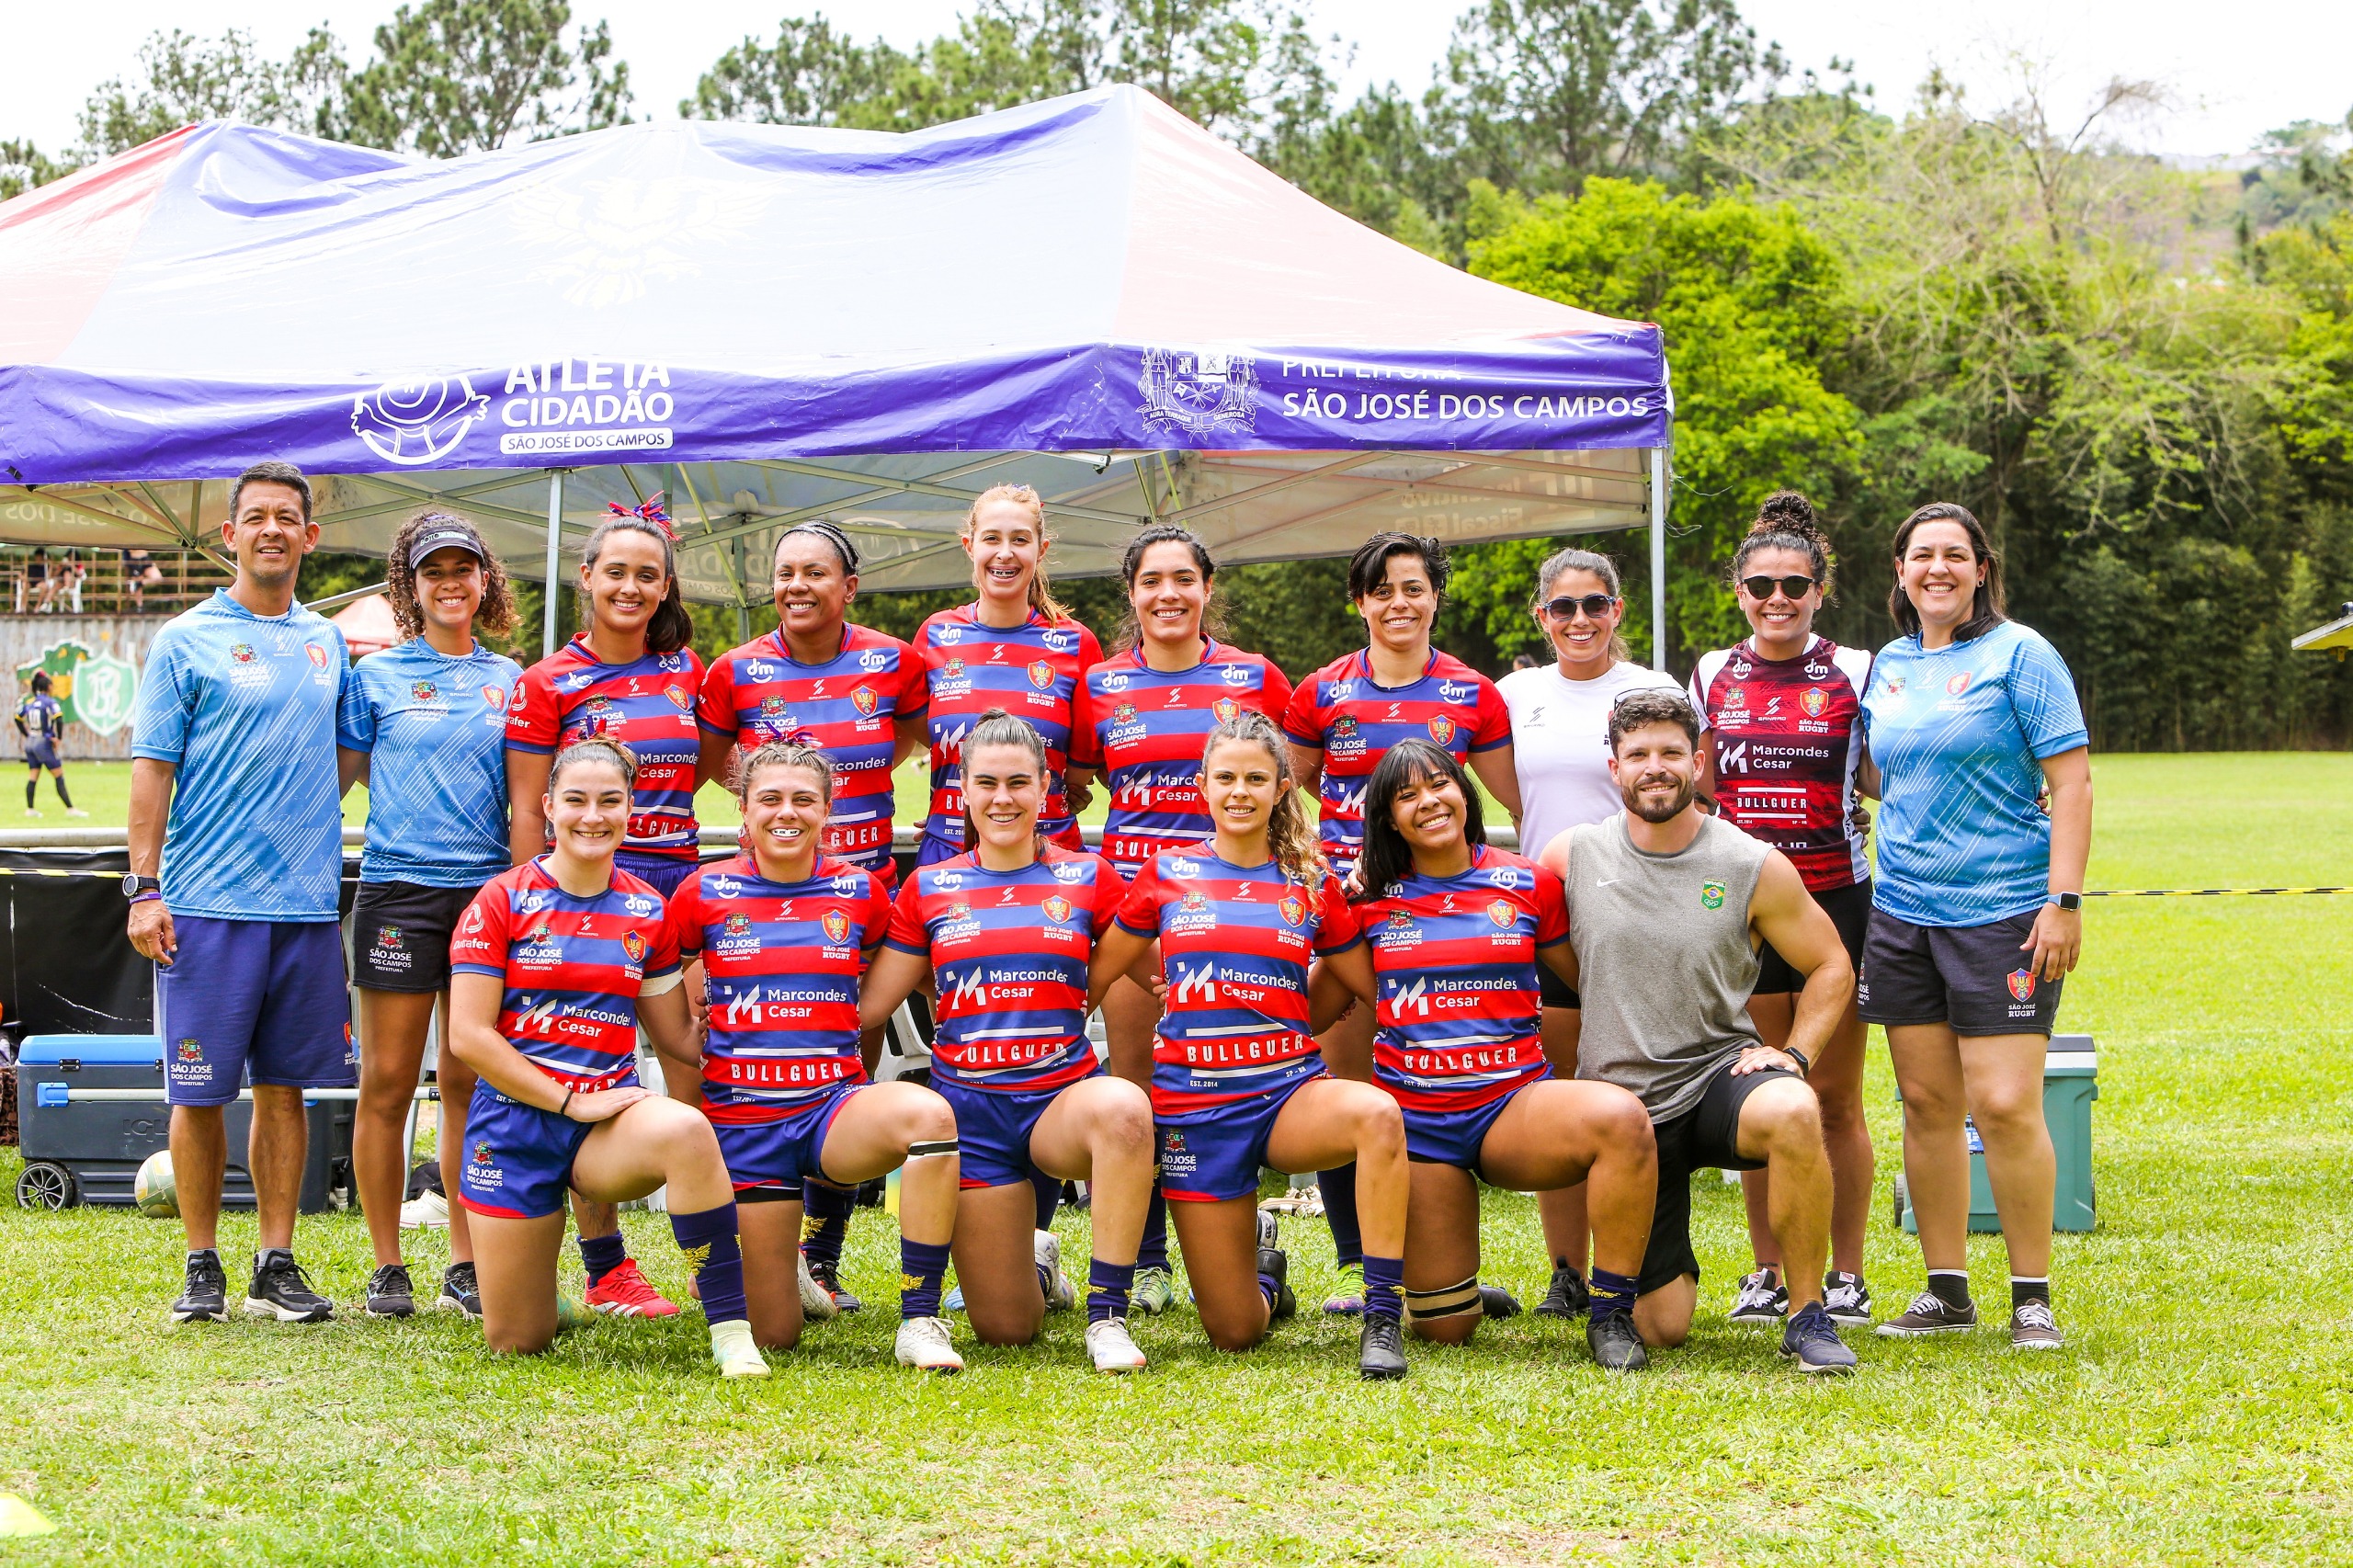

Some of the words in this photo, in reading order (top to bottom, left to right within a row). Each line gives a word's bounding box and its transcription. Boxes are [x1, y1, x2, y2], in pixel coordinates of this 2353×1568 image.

[502, 390, 674, 427] CIDADÃO
[1282, 389, 1347, 418] SÃO
[1354, 389, 1429, 419] JOSÉ
[1439, 394, 1505, 419] DOS
[1513, 395, 1649, 418] CAMPOS
[508, 435, 534, 449] SÃO
[539, 433, 571, 449] JOSÉ
[574, 435, 603, 448] DOS
[607, 433, 664, 447] CAMPOS
[935, 681, 949, 691] SÃO
[949, 679, 972, 688] JOSÉ
[1027, 698, 1055, 708] RUGBY
[1731, 710, 1750, 718] JOSÉ
[856, 723, 881, 732] RUGBY
[1108, 727, 1124, 741] SÃO
[1125, 723, 1146, 735] JOSÉ
[1798, 725, 1828, 733] RUGBY
[1108, 739, 1119, 747] DOS
[1120, 734, 1146, 744] CAMPOS
[1114, 742, 1138, 751] PREFEITURA
[1342, 738, 1367, 749] JOSÉ
[1753, 744, 1829, 757] Marcondes
[831, 756, 886, 772] rcondes
[1753, 758, 1791, 769] Cesar
[640, 768, 676, 778] Cesar
[1156, 790, 1198, 802] Cesar
[1737, 798, 1806, 808] BULLGUER
[831, 826, 879, 847] GUER
[1171, 915, 1191, 926] SÃO
[1190, 913, 1216, 925] JOSÉ
[938, 924, 954, 937] SÃO
[955, 921, 981, 932] JOSÉ
[1278, 928, 1292, 937] SÃO
[1292, 932, 1305, 941] JOSÉ
[1380, 931, 1397, 942] SÃO
[1398, 928, 1423, 939] JOSÉ
[716, 938, 733, 949] SÃO
[734, 937, 760, 948] JOSÉ
[938, 935, 949, 944] DOS
[949, 929, 981, 940] CAMPOS
[942, 937, 971, 947] PREFEITURA
[1043, 932, 1073, 942] RUGBY
[1277, 935, 1305, 949] RUGBY
[1392, 938, 1422, 947] CAMPOS
[369, 948, 387, 960] SÃO
[388, 951, 412, 961] JOSÉ
[517, 947, 537, 958] SÃO
[537, 948, 563, 958] JOSÉ
[730, 946, 760, 955] CAMPOS
[823, 952, 850, 960] RUGBY
[382, 960, 412, 968] CAMPOS
[533, 957, 562, 966] CAMPOS
[990, 970, 1068, 983] Marcondes
[1221, 967, 1298, 992] Marcondes
[991, 985, 1034, 999] Cesar
[1434, 978, 1517, 993] Marcondes
[768, 989, 847, 1003] Marcondes
[1222, 983, 1265, 1002] Cesar
[1435, 994, 1480, 1009] Cesar
[768, 1005, 813, 1017] Cesar
[558, 1020, 602, 1038] Cesar
[1187, 1033, 1304, 1062] BULLGUER
[1404, 1047, 1517, 1070] BULLGUER
[171, 1062, 188, 1074] SÃO
[189, 1063, 212, 1074] JOSÉ
[732, 1062, 844, 1082] BULLGUER
[1286, 1070, 1294, 1078] SP
[1298, 1066, 1306, 1074] BR
[496, 1094, 506, 1104] EST.
[123, 1119, 170, 1142] IGL
[1162, 1154, 1176, 1165] SÃO
[1176, 1153, 1196, 1165] JOSÉ
[467, 1165, 482, 1178] SÃO
[483, 1167, 503, 1179] JOSÉ
[467, 1176, 479, 1185] DOS
[479, 1177, 503, 1187] CAMPOS
[472, 1184, 494, 1192] PREFEITURA
